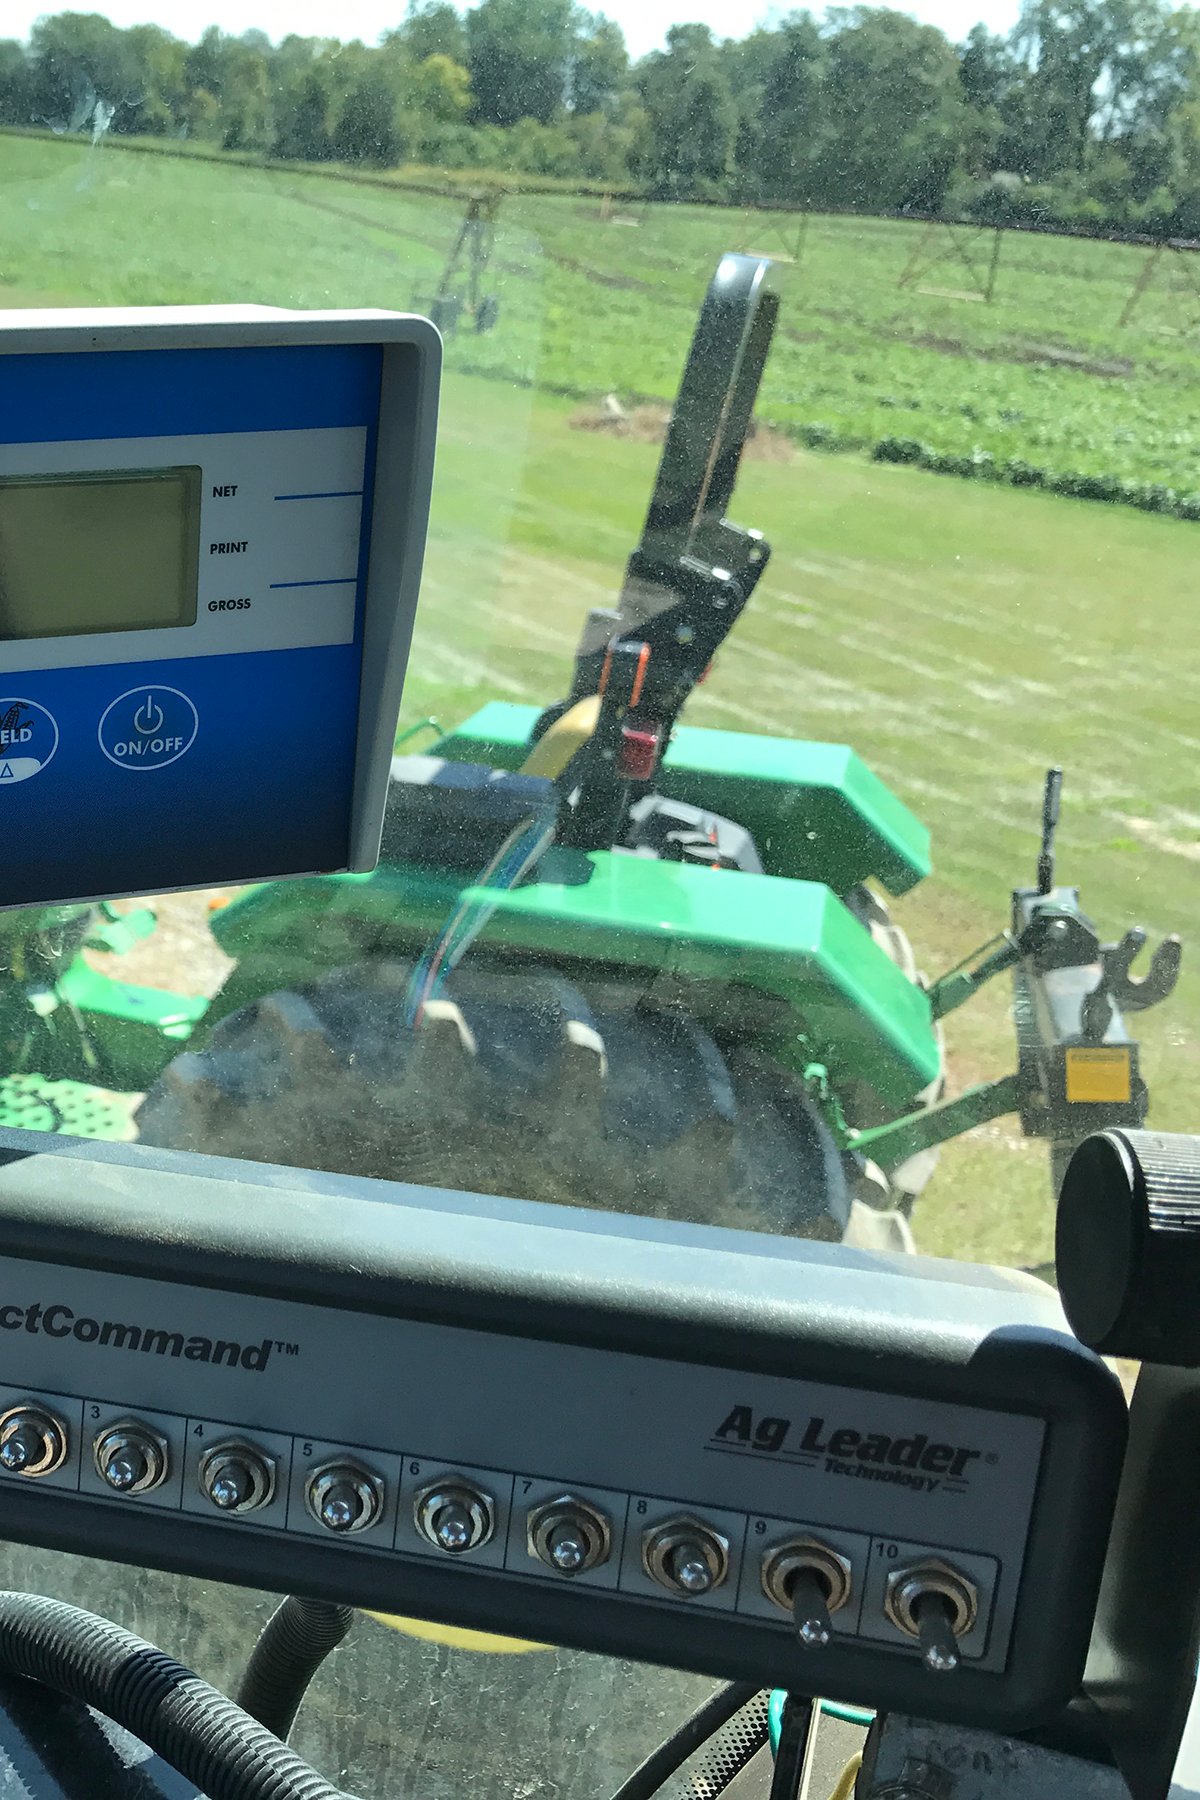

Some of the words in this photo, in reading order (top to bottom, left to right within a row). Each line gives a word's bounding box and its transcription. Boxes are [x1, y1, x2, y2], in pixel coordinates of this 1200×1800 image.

[212, 485, 238, 498] NET
[209, 541, 248, 554] PRINT
[207, 598, 251, 612] GROSS
[113, 736, 184, 756] ON/OFF
[90, 1406, 100, 1419] 3
[193, 1424, 204, 1437] 4
[715, 1404, 791, 1452] Ag
[303, 1444, 312, 1457] 5
[409, 1462, 420, 1476] 6
[824, 1458, 940, 1492] Technology
[522, 1480, 532, 1495] 7
[636, 1500, 647, 1515] 8
[755, 1520, 766, 1536] 9
[875, 1541, 899, 1560] 10
